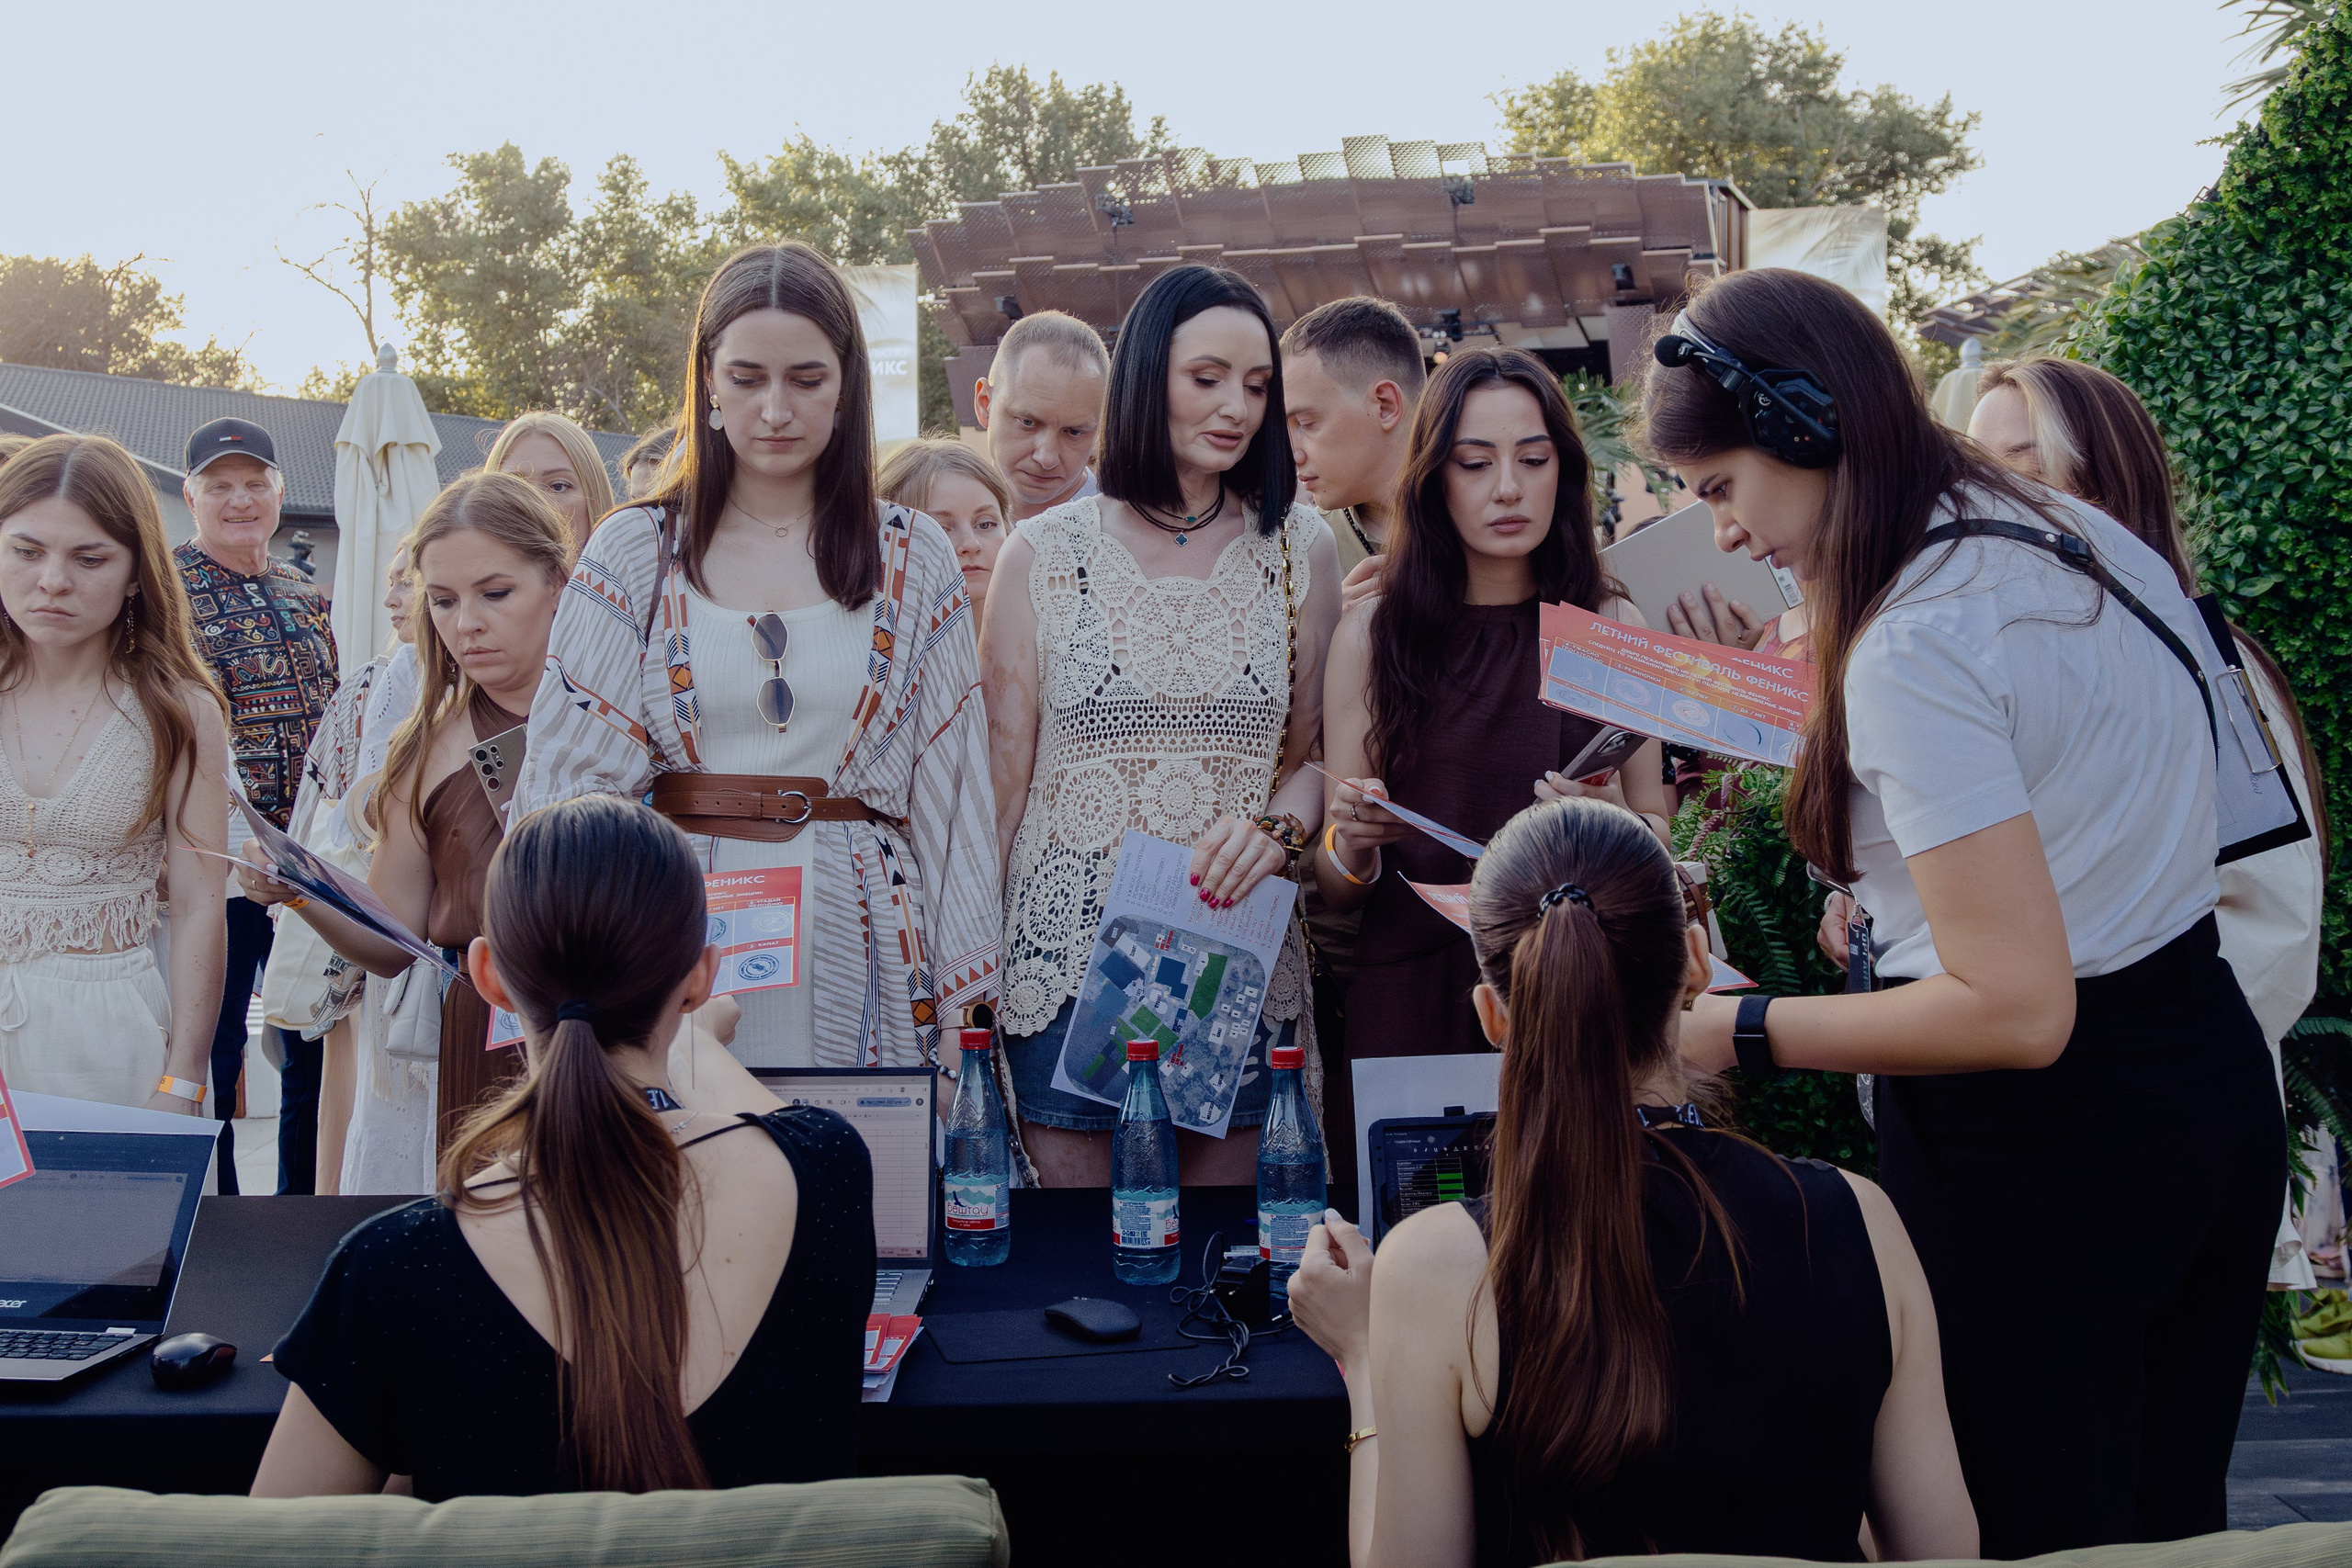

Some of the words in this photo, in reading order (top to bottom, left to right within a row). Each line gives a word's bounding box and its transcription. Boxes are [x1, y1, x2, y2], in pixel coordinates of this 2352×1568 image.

[869, 359, 908, 376] ИКС
[1562, 645, 1604, 664] ТРОГАТЕЛЬНО
[1572, 644, 1600, 658] УЖАСНО
[1590, 622, 1648, 649] ЛЕТНИЙ
[1653, 644, 1742, 681] ФЕСТИВАЛЬ
[1746, 675, 1810, 703] ФЕНИКС
[1624, 666, 1661, 682] РЕЗИНОЧКИ
[947, 1201, 989, 1217] Бештау
[0, 1300, 28, 1308] acer
